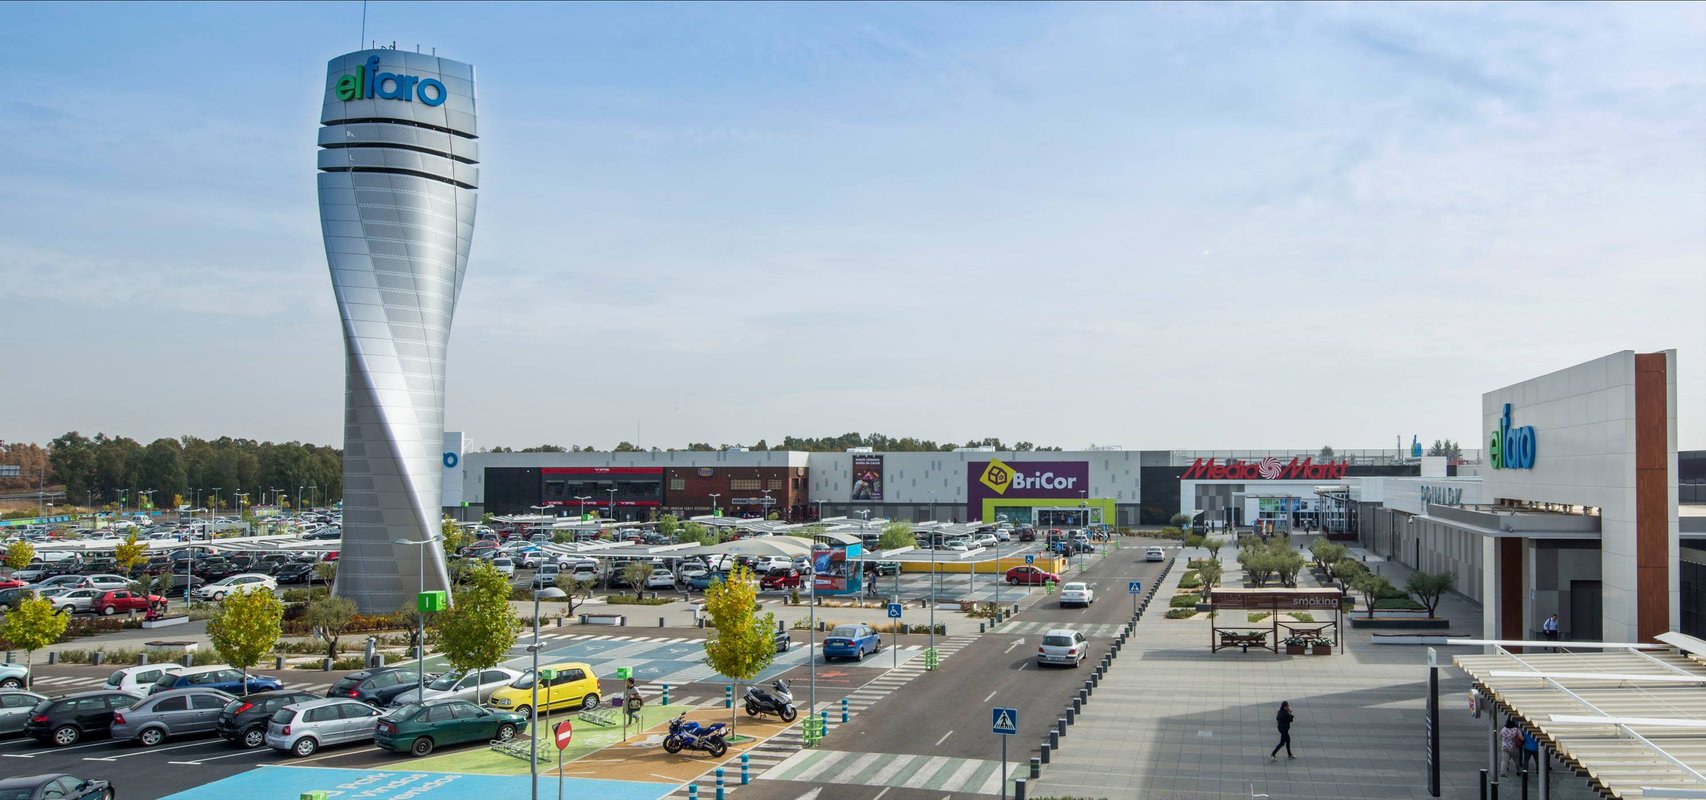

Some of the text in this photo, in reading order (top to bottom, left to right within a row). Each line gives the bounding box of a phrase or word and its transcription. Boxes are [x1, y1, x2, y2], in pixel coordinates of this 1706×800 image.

[1182, 456, 1350, 480] Media Markt
[1012, 471, 1076, 489] BriCor
[1293, 597, 1338, 608] smoking
